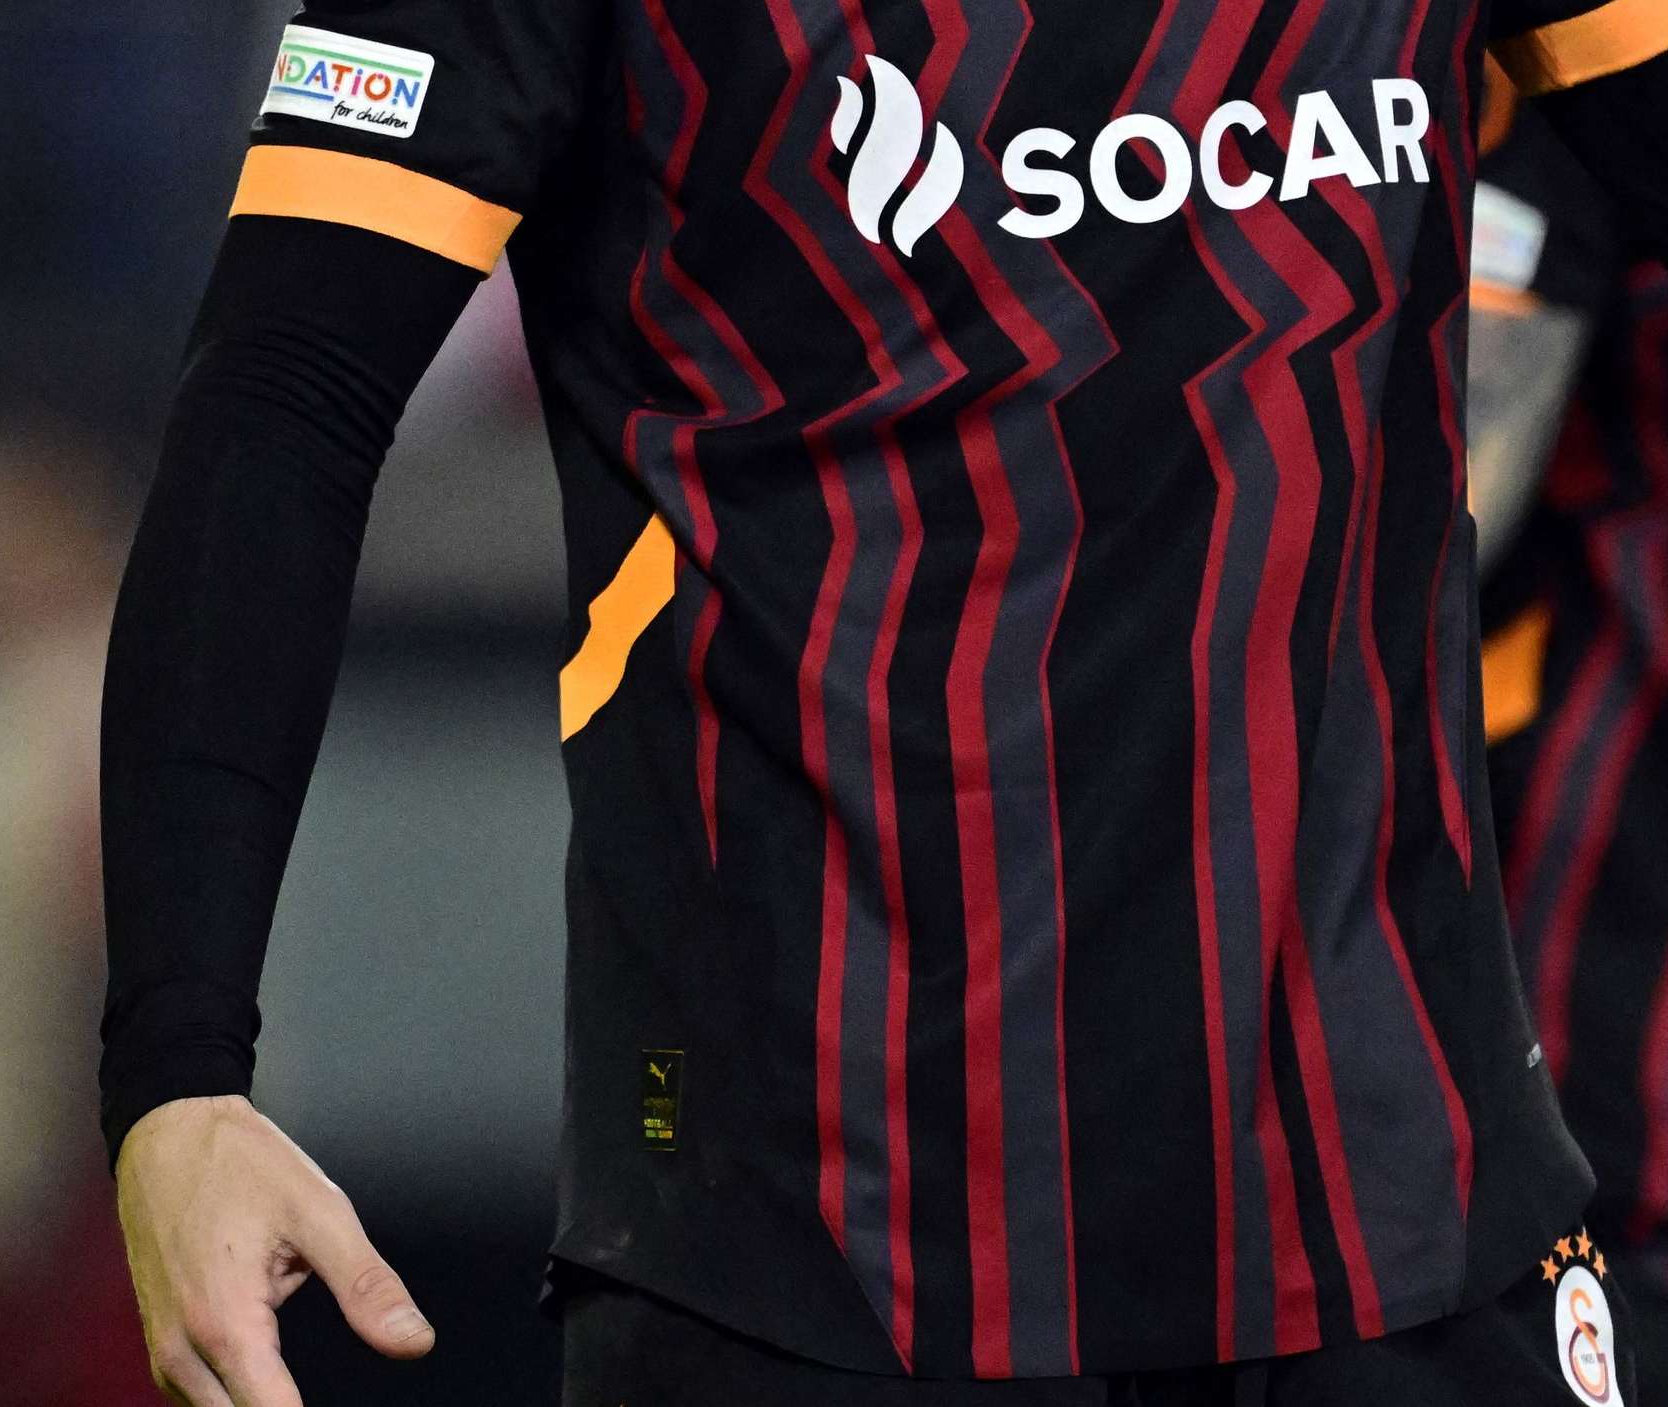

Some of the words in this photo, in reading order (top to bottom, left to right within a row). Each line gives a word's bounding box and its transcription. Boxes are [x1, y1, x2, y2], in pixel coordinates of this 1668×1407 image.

[331, 99, 354, 120] for
[356, 107, 409, 129] children
[997, 78, 1430, 239] SOCAR
